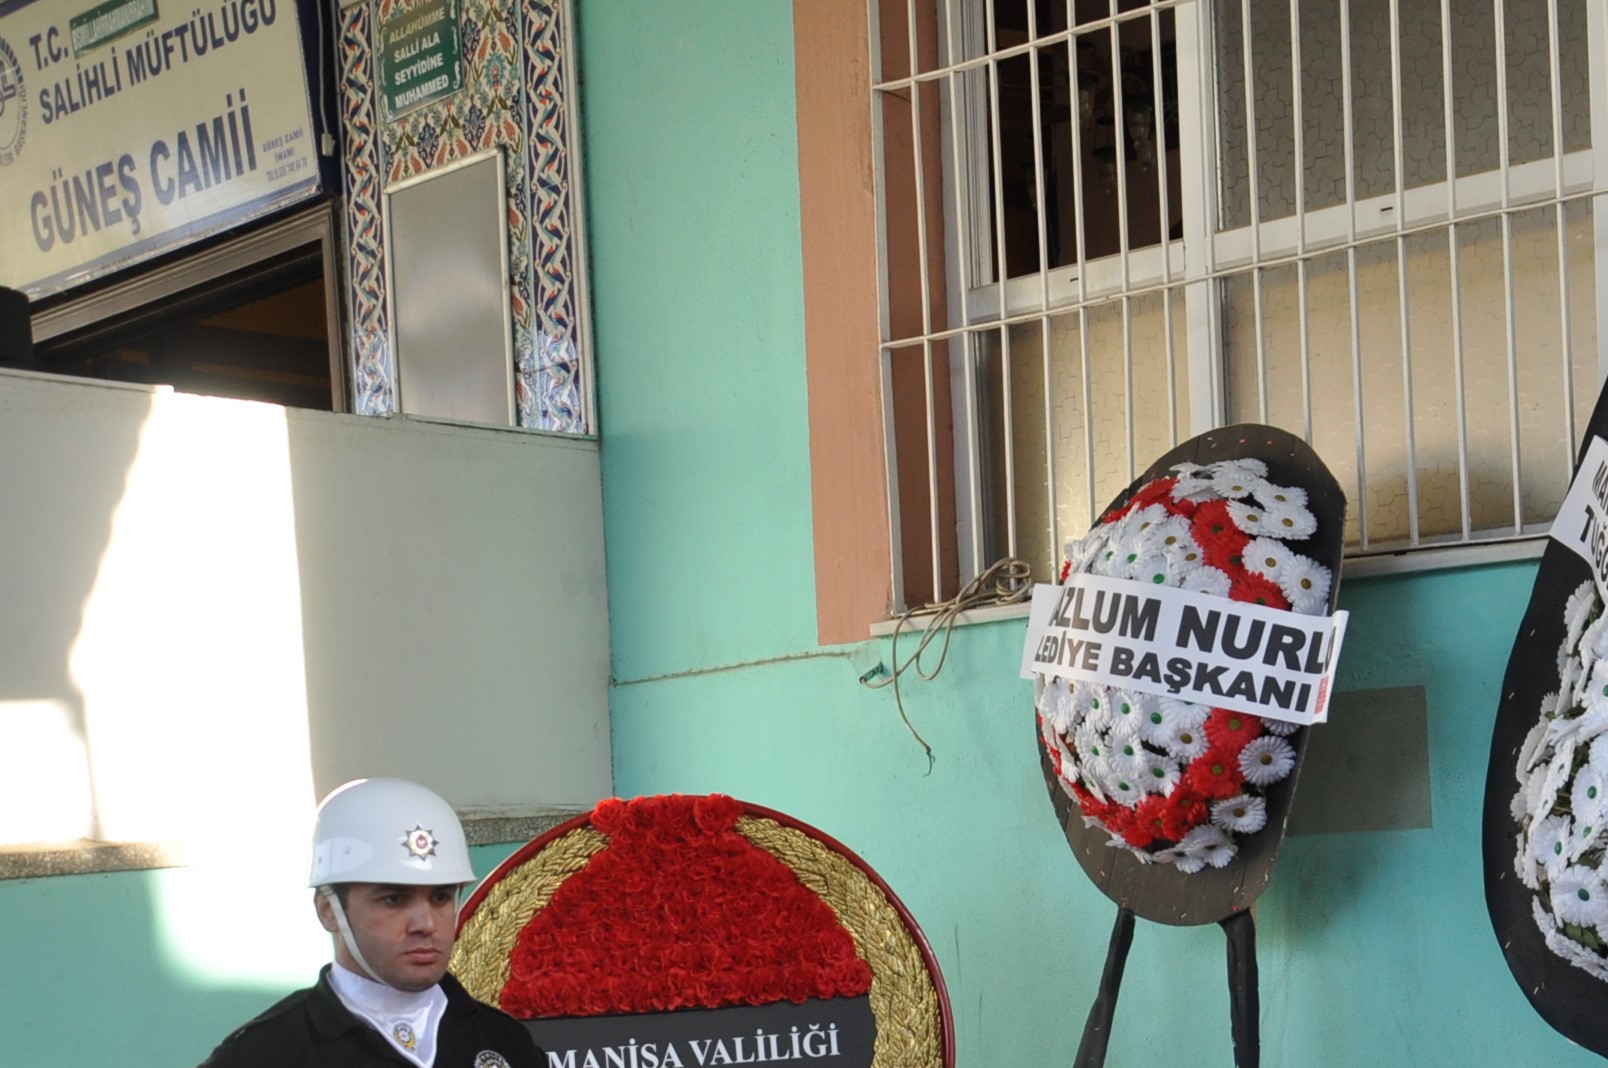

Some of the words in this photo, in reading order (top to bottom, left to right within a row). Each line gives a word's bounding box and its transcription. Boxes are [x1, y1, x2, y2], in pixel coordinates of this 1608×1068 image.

[29, 26, 69, 70] T.C.
[422, 32, 441, 51] ALA
[39, 46, 122, 125] SALİHLİ
[394, 52, 444, 86] SEYYİDİNE
[395, 74, 449, 109] MUHAMMED
[30, 152, 143, 252] GÜNEŞ
[150, 88, 257, 206] CAMİİ
[1109, 645, 1312, 713] BAŞKANI
[688, 1022, 841, 1066] VALİLİĞİ
